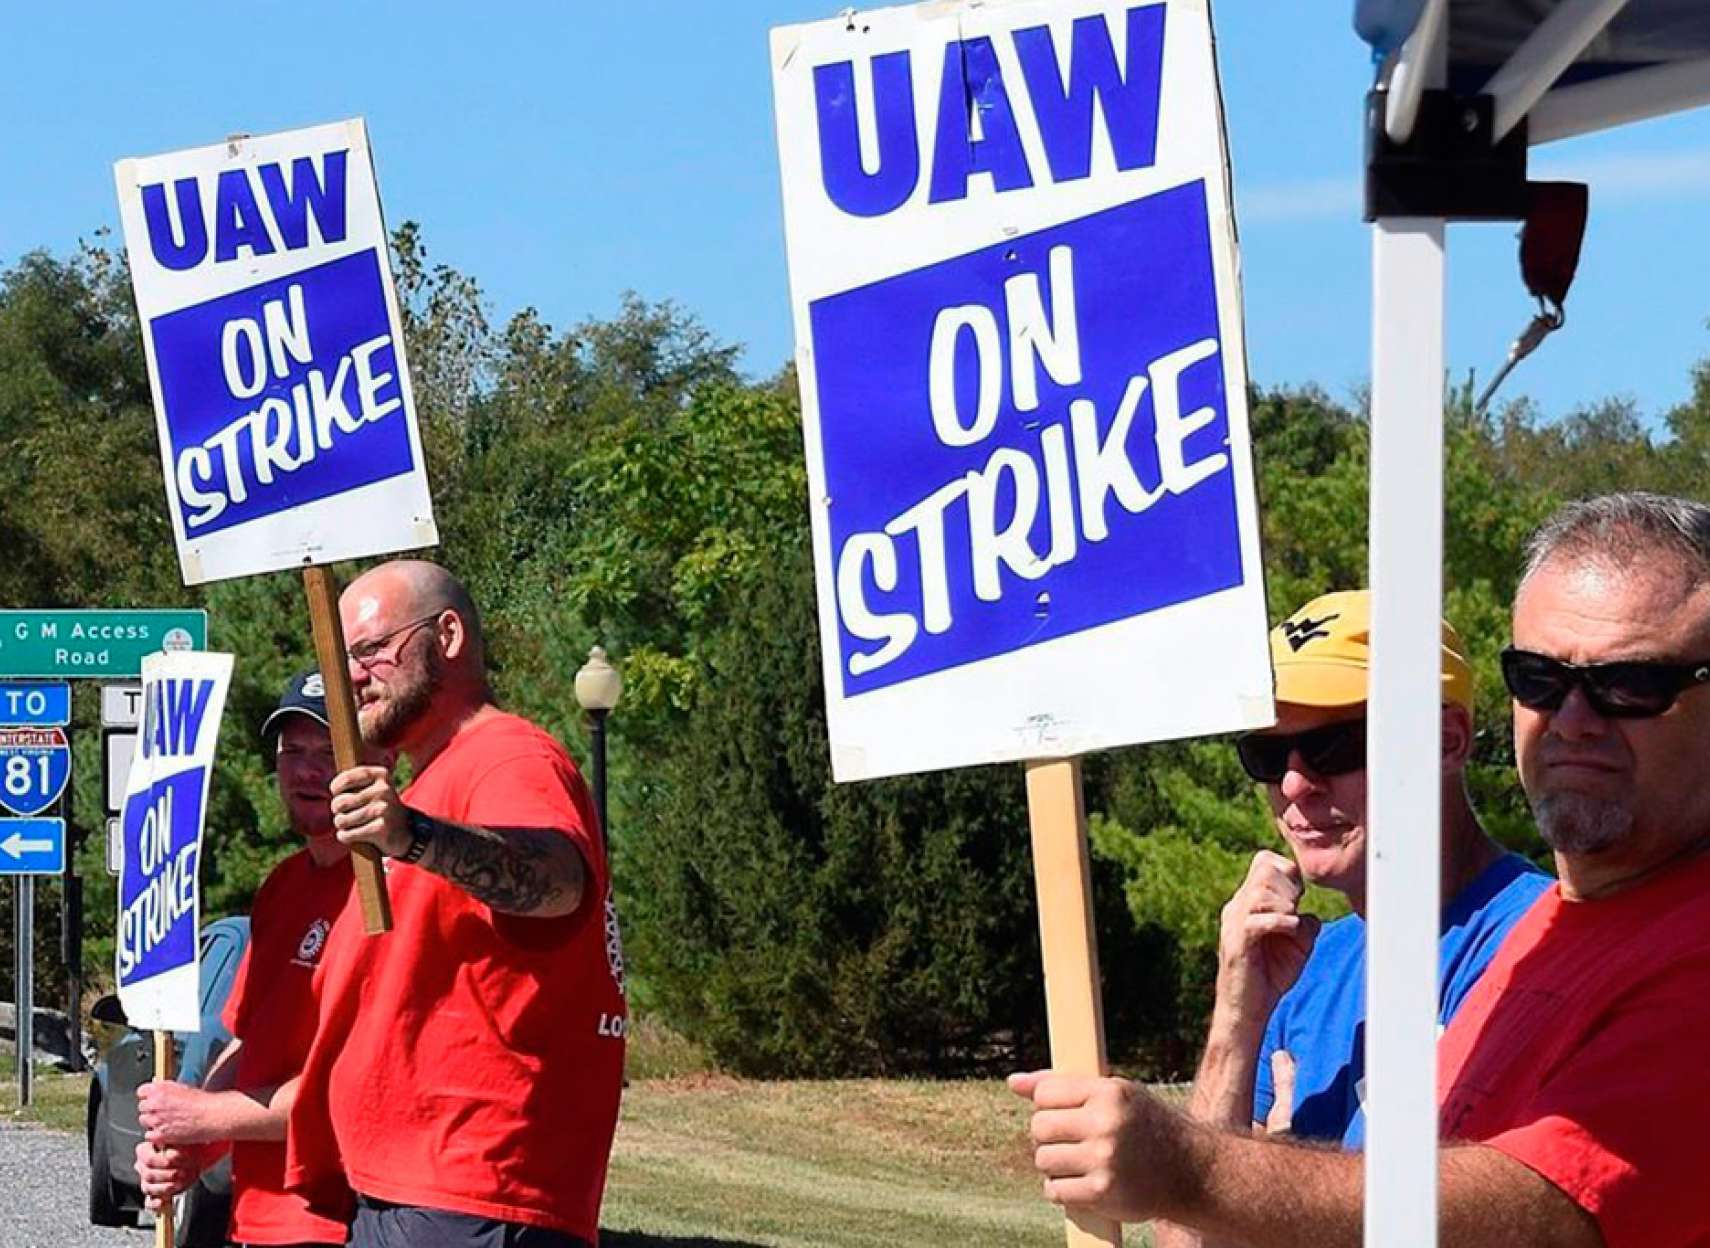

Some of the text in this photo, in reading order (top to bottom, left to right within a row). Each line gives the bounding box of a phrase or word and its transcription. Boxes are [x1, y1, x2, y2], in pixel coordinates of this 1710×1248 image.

[813, 2, 1167, 218] UAW
[141, 149, 350, 271] UAW
[221, 284, 313, 400] ON
[929, 245, 1082, 447] ON
[177, 335, 401, 527] STRIKE
[836, 337, 1228, 676] STRIKE
[55, 648, 109, 666] Road
[71, 622, 149, 640] Access
[6, 690, 46, 716] TO
[5, 754, 49, 796] 81
[140, 785, 173, 876] ON
[120, 842, 197, 978] STRIKE
[597, 1012, 628, 1039] LO
